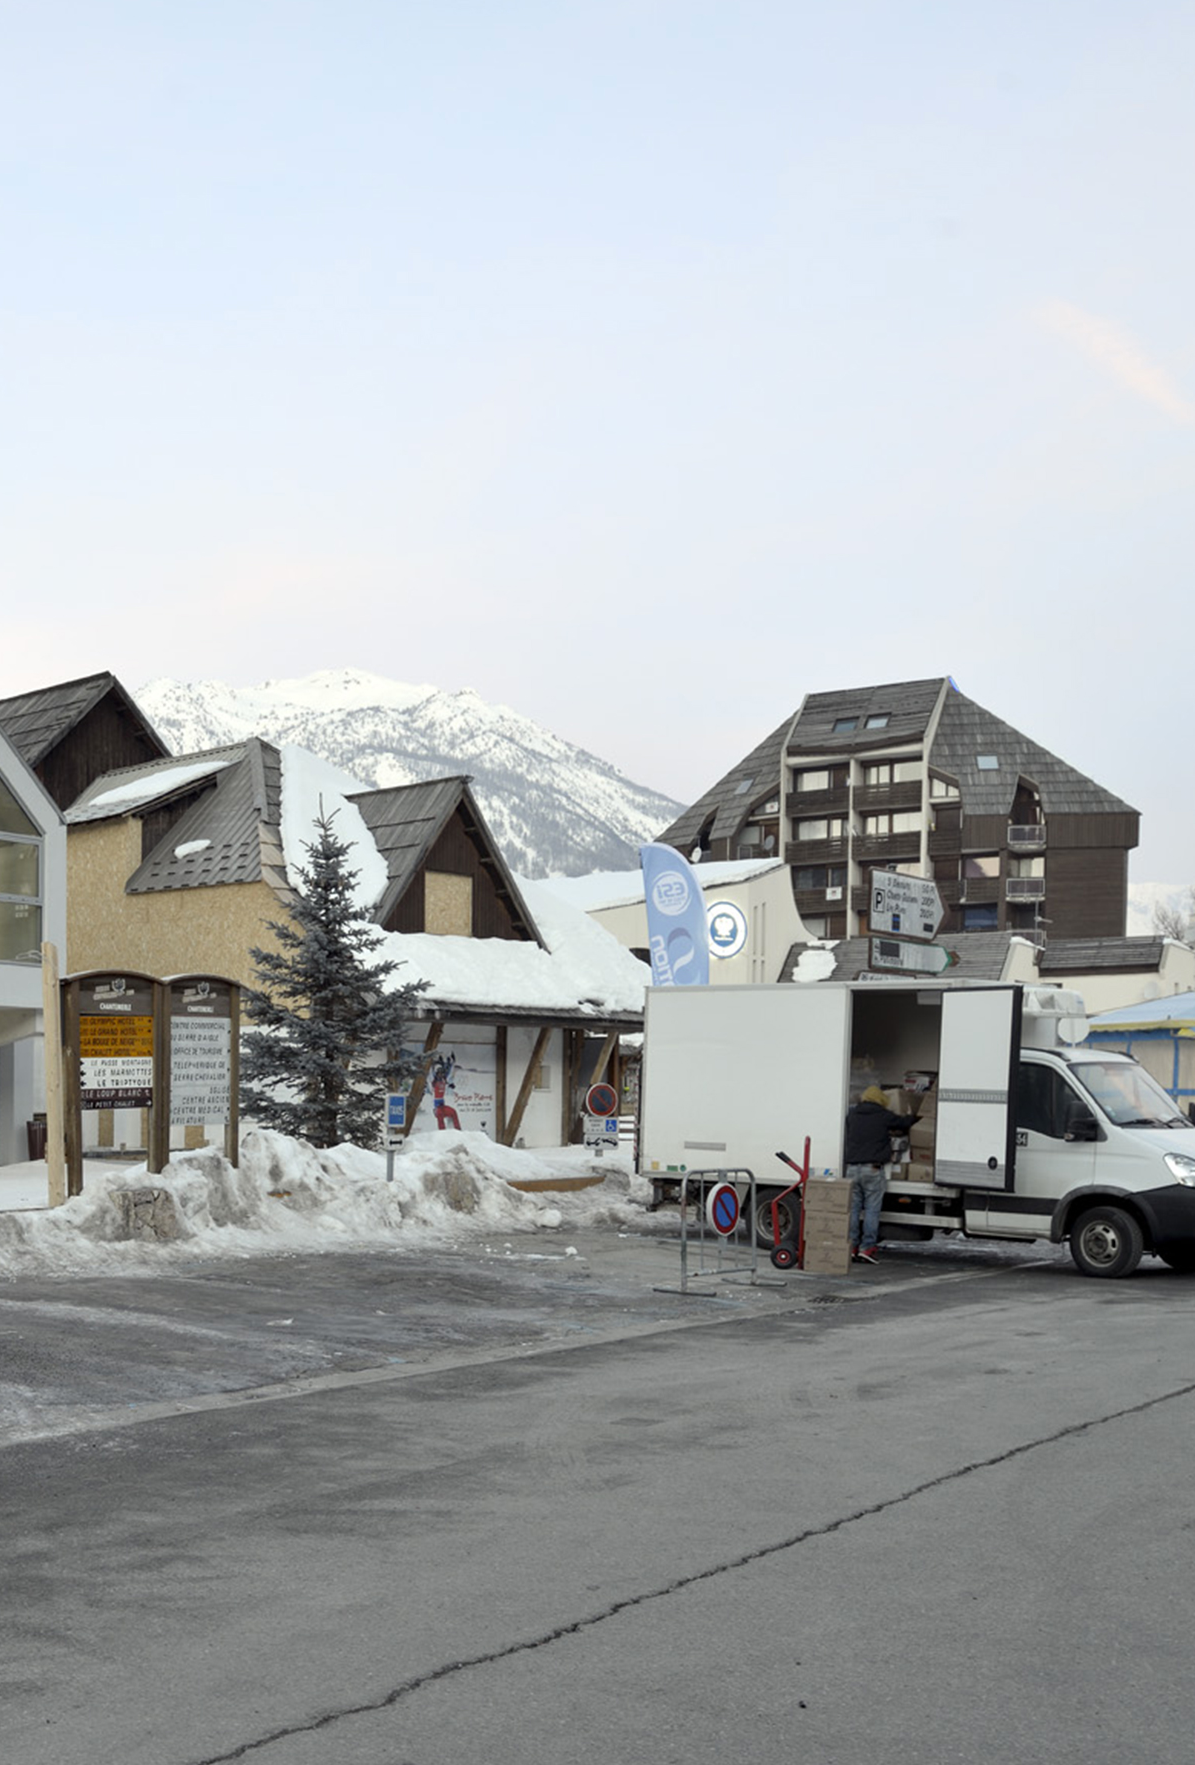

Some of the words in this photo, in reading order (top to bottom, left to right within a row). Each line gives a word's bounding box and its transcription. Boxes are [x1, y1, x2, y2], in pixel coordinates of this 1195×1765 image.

[94, 1069, 106, 1077] LES
[97, 1079, 106, 1087] LE
[86, 1090, 94, 1098] LE
[97, 1089, 116, 1097] LOUP
[118, 1088, 143, 1097] BLANC
